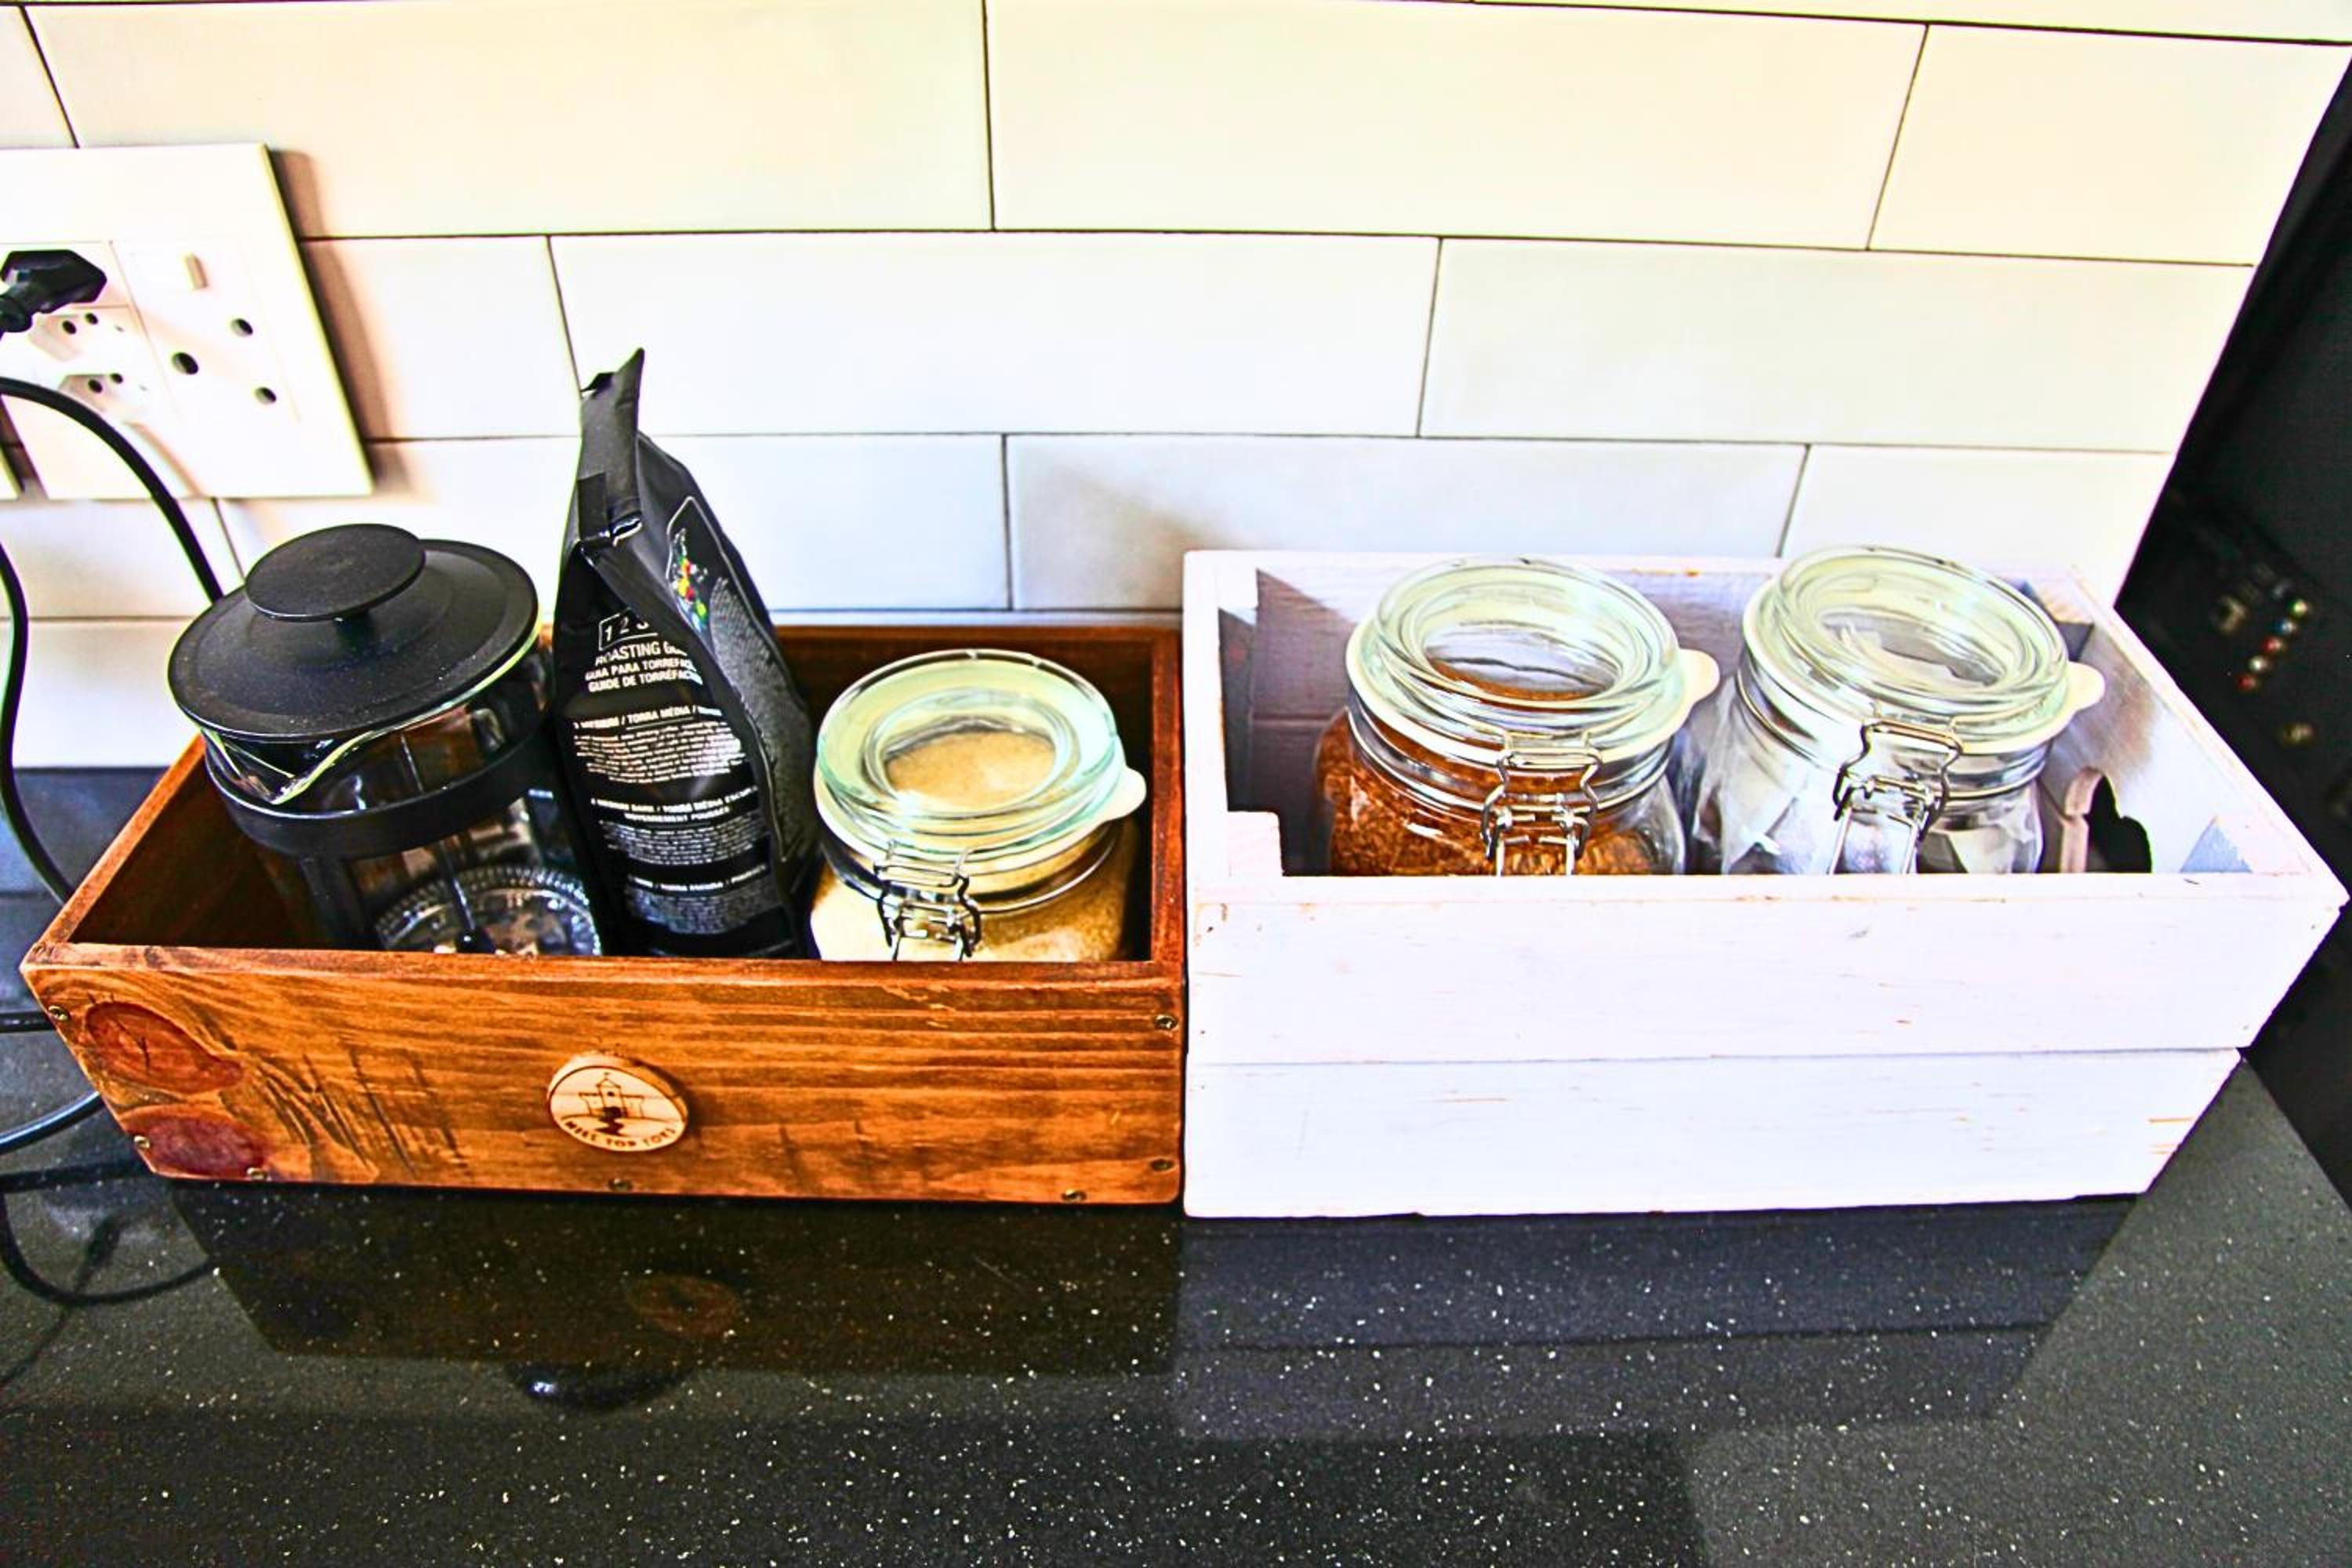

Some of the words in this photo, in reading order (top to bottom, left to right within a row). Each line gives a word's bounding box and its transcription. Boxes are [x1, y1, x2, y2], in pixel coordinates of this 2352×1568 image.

[604, 625, 612, 641] 1
[619, 616, 630, 634] 2
[595, 641, 661, 666] ROASTING
[611, 662, 641, 675] PARA
[588, 677, 621, 692] GUIDE
[622, 675, 638, 688] DE
